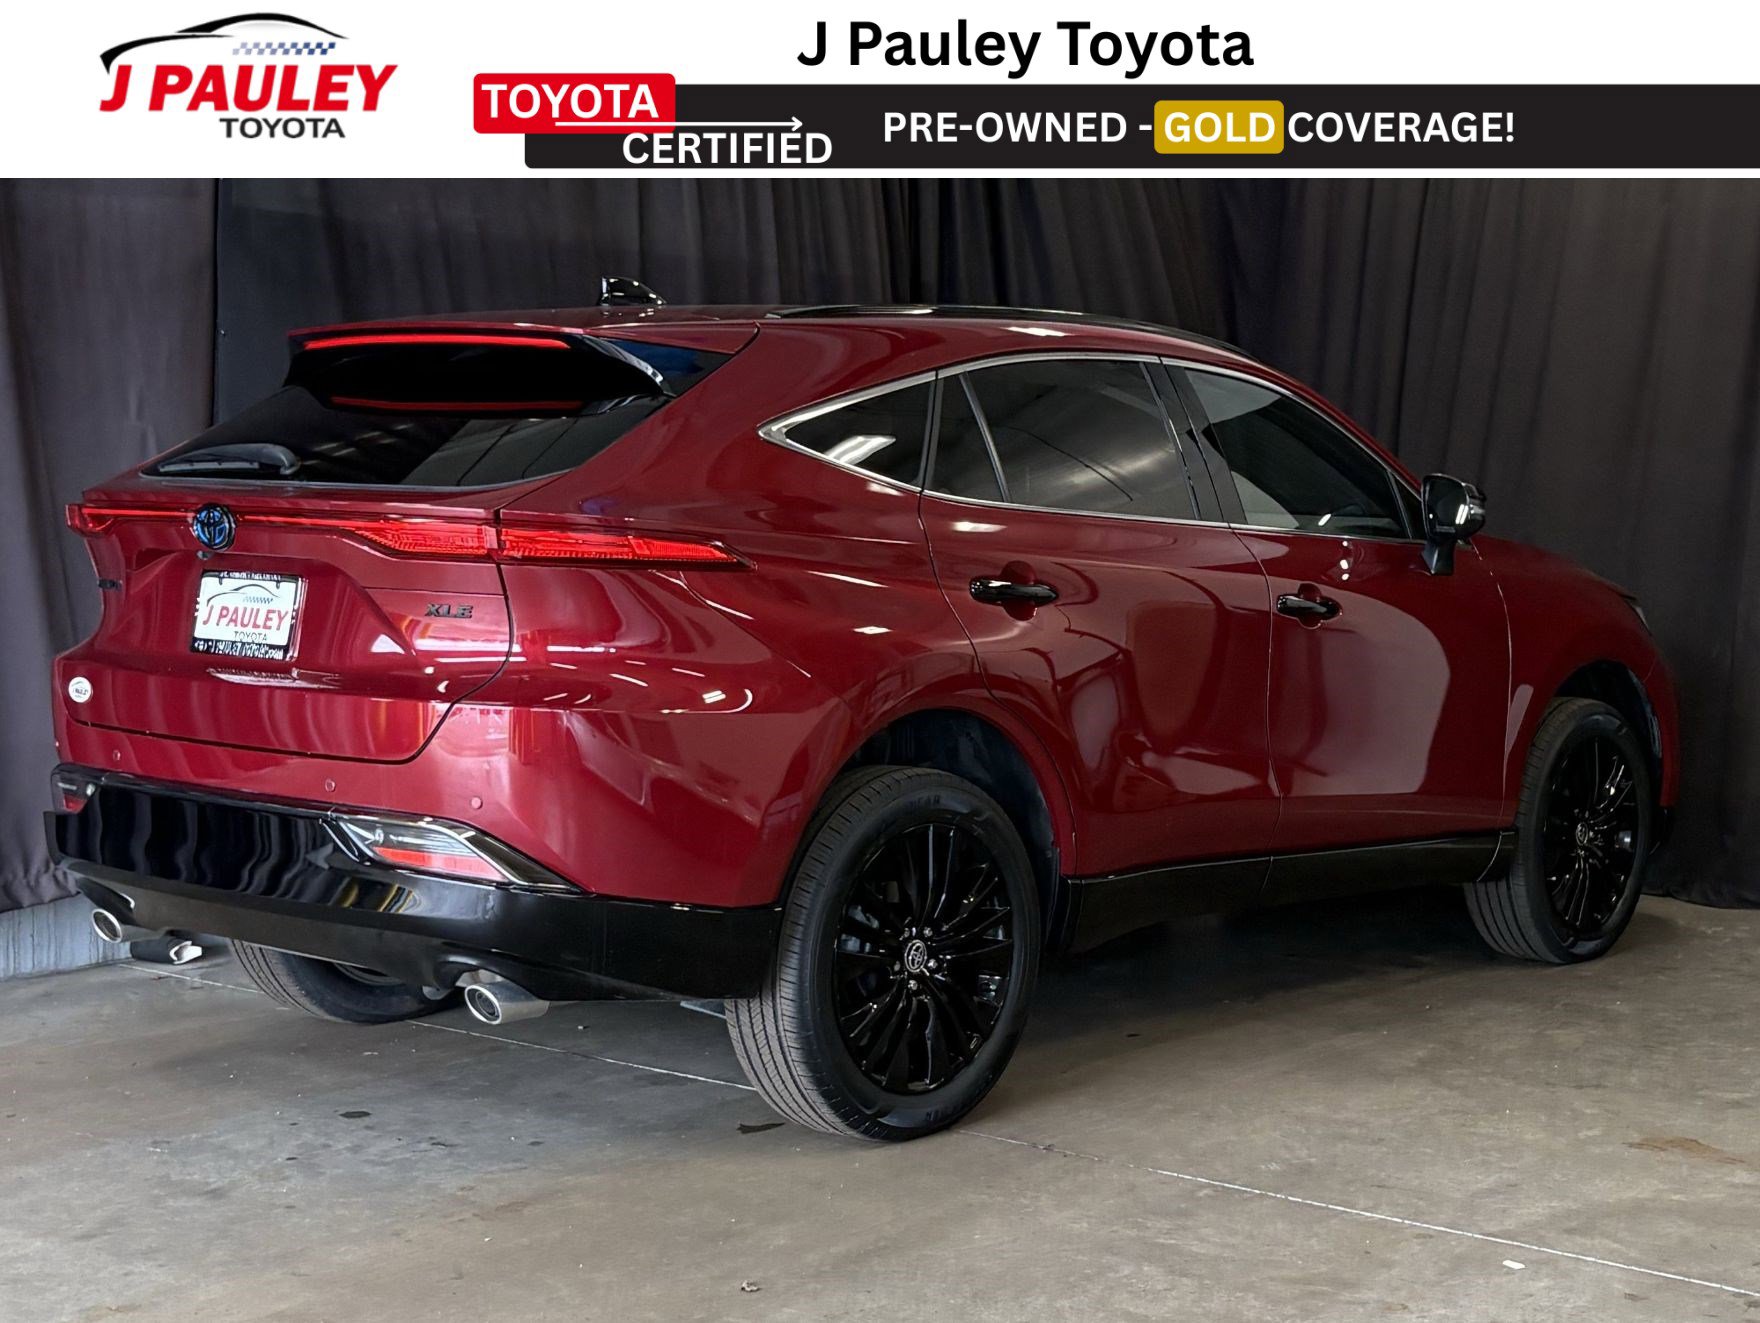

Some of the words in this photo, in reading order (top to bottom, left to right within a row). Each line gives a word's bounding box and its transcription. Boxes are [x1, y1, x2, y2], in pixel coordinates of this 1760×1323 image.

[202, 604, 214, 626] J
[215, 605, 289, 631] PAULEY
[424, 602, 474, 619] XLE
[234, 630, 268, 642] TOYOTA
